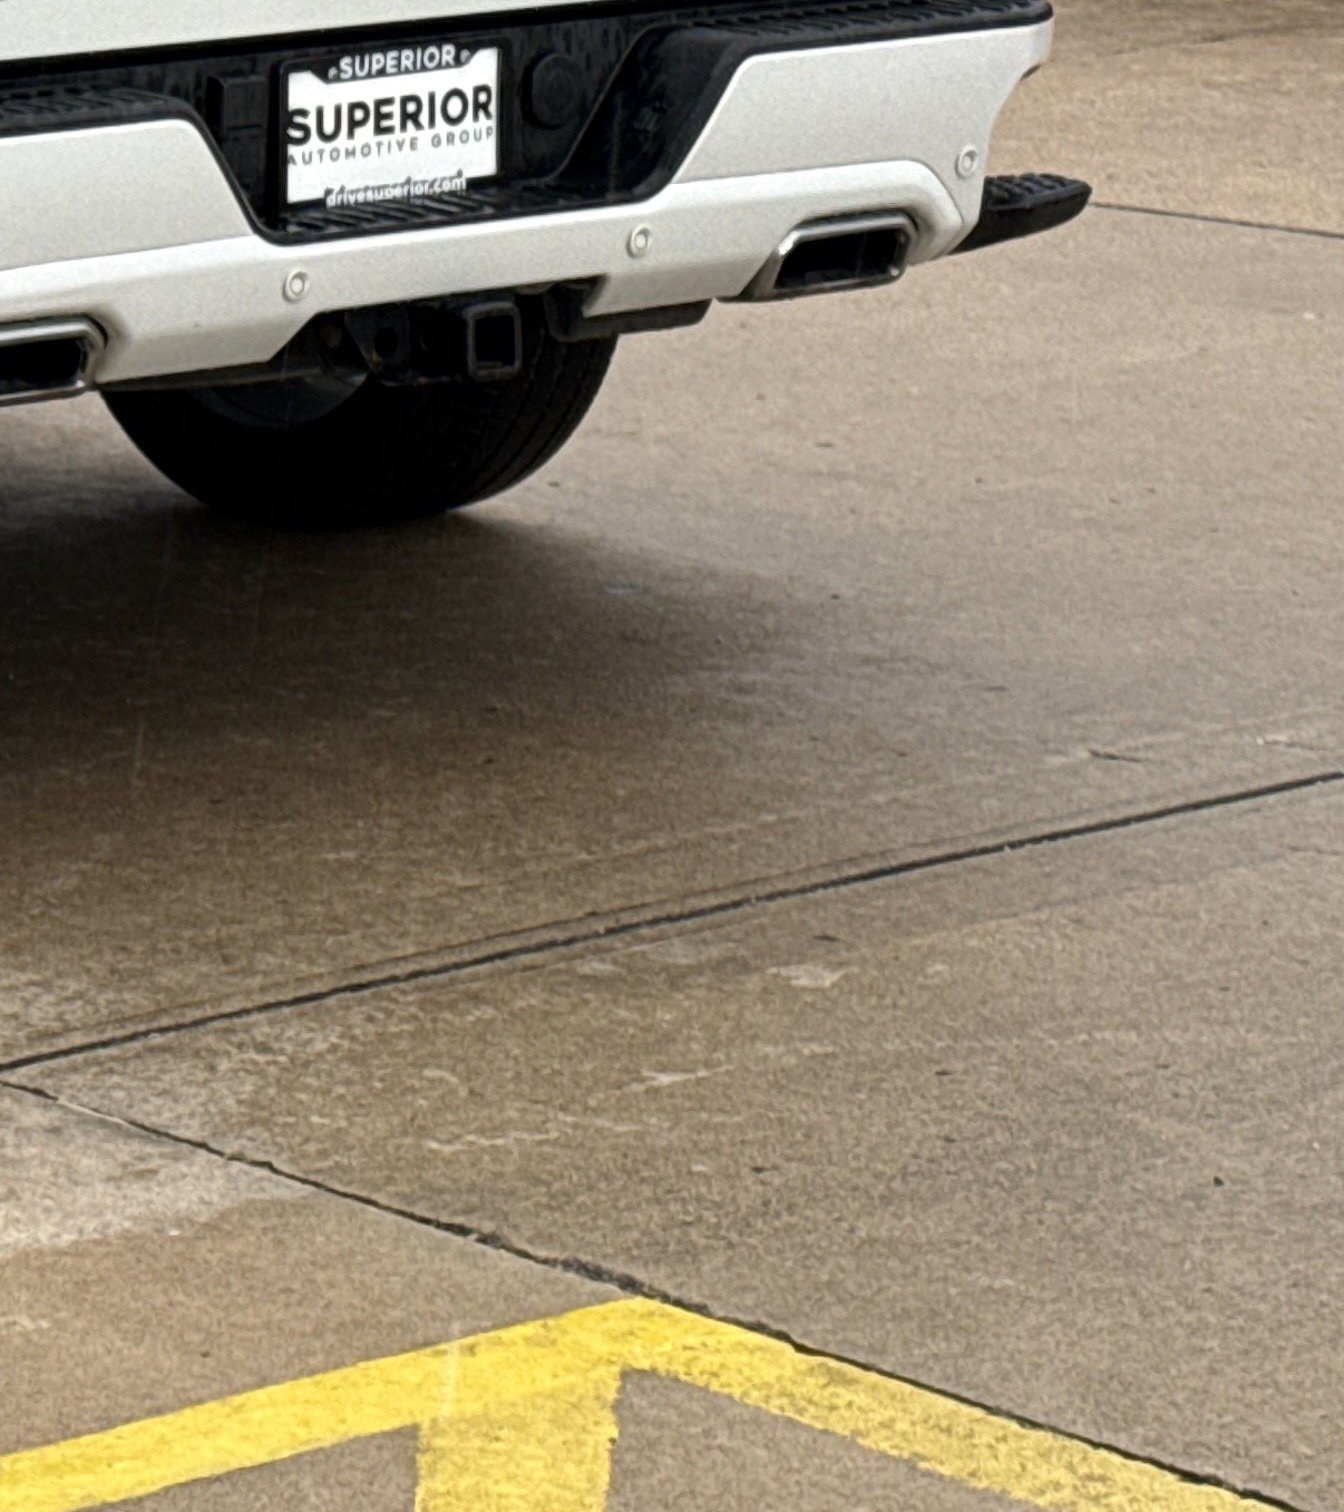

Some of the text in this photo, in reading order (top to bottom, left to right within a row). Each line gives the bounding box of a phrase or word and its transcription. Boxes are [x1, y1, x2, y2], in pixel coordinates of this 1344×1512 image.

[339, 44, 456, 80] SUPERIOR
[285, 84, 493, 147] SUPERIOR
[287, 126, 494, 166] AUTOMOTIVE GROUP
[325, 176, 467, 209] drivesuperior.com
